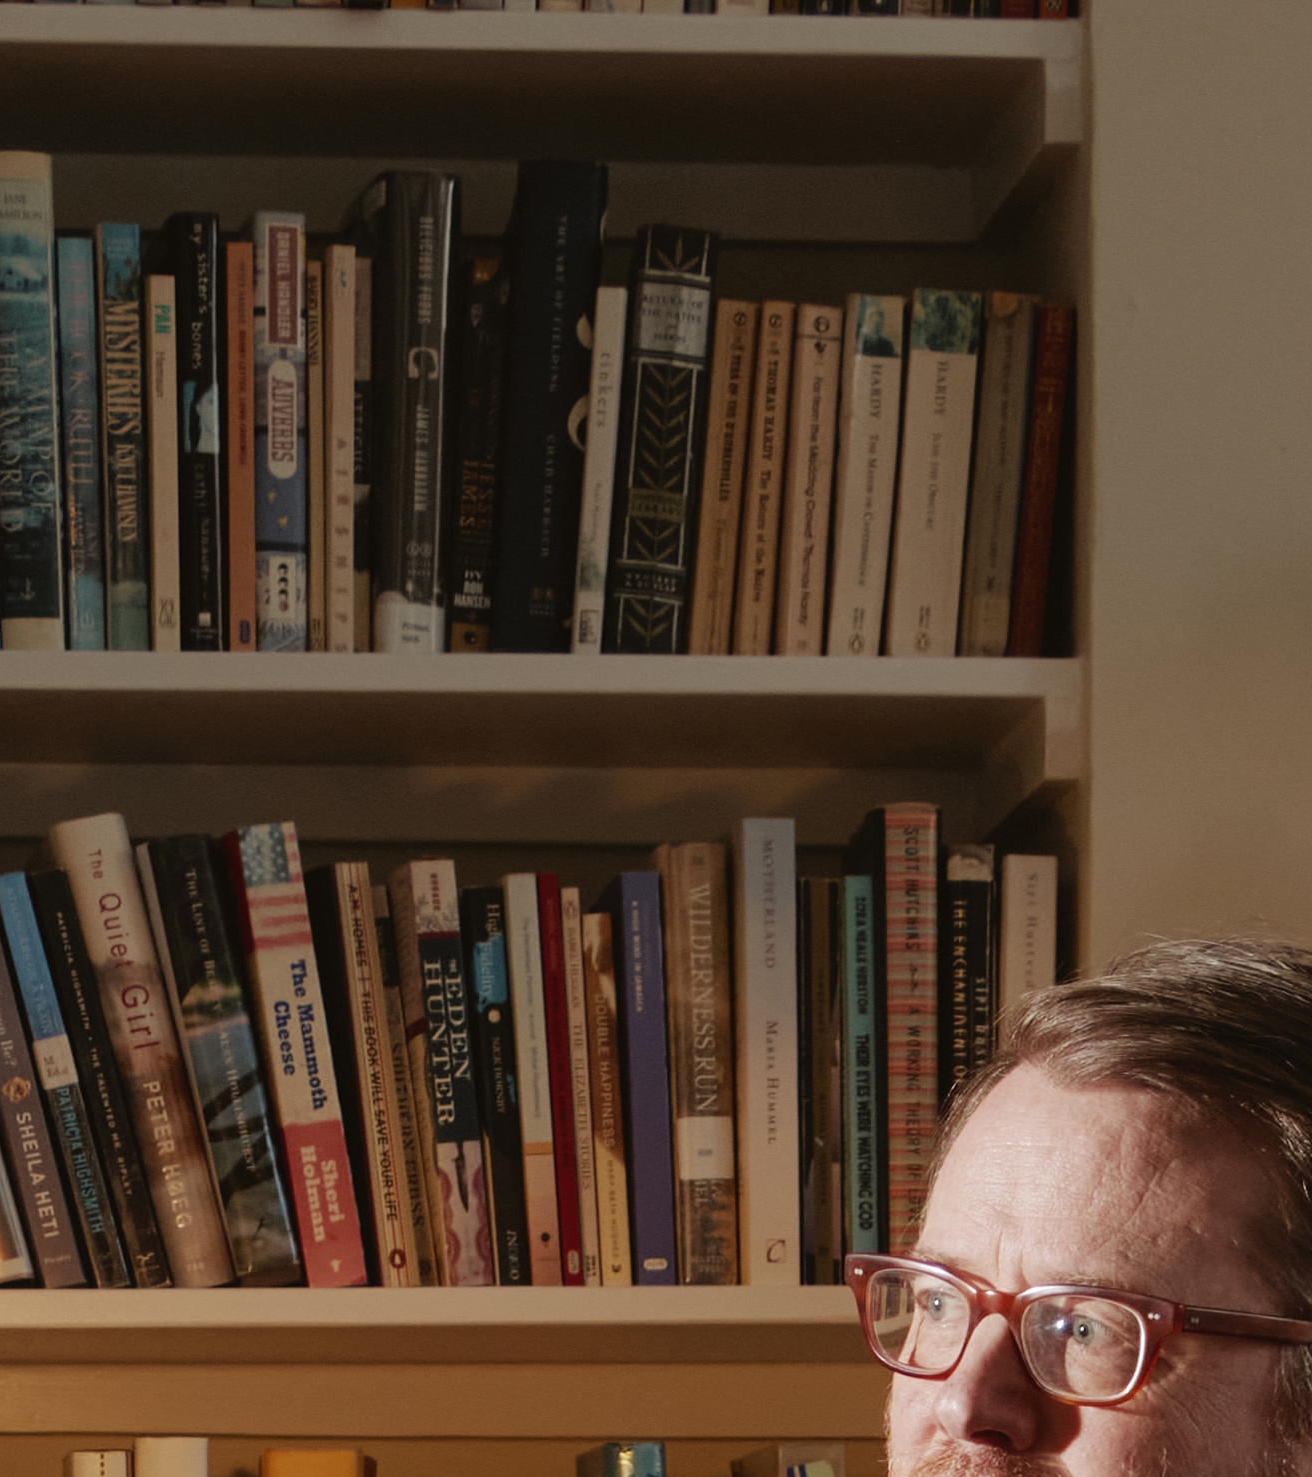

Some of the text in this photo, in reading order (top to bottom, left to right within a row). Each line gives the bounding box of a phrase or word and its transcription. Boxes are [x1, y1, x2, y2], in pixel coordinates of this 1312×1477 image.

[103, 300, 142, 435] MYSTERIES
[269, 376, 295, 462] ADVERBS
[87, 849, 159, 1051] The Quiet Girl
[273, 1000, 299, 1076] Cheese
[290, 960, 328, 1110] The Mammoth
[422, 958, 456, 1125] HUNTER
[443, 974, 471, 1081] EDEN
[0, 1040, 17, 1067] Be?
[14, 1111, 45, 1186] SHEILA
[34, 1191, 60, 1239] HETI
[362, 992, 398, 1222] THIS BOOK WILL SAVE YOUR LIFE
[299, 1145, 328, 1242] Holman
[320, 1159, 344, 1223] Sheri
